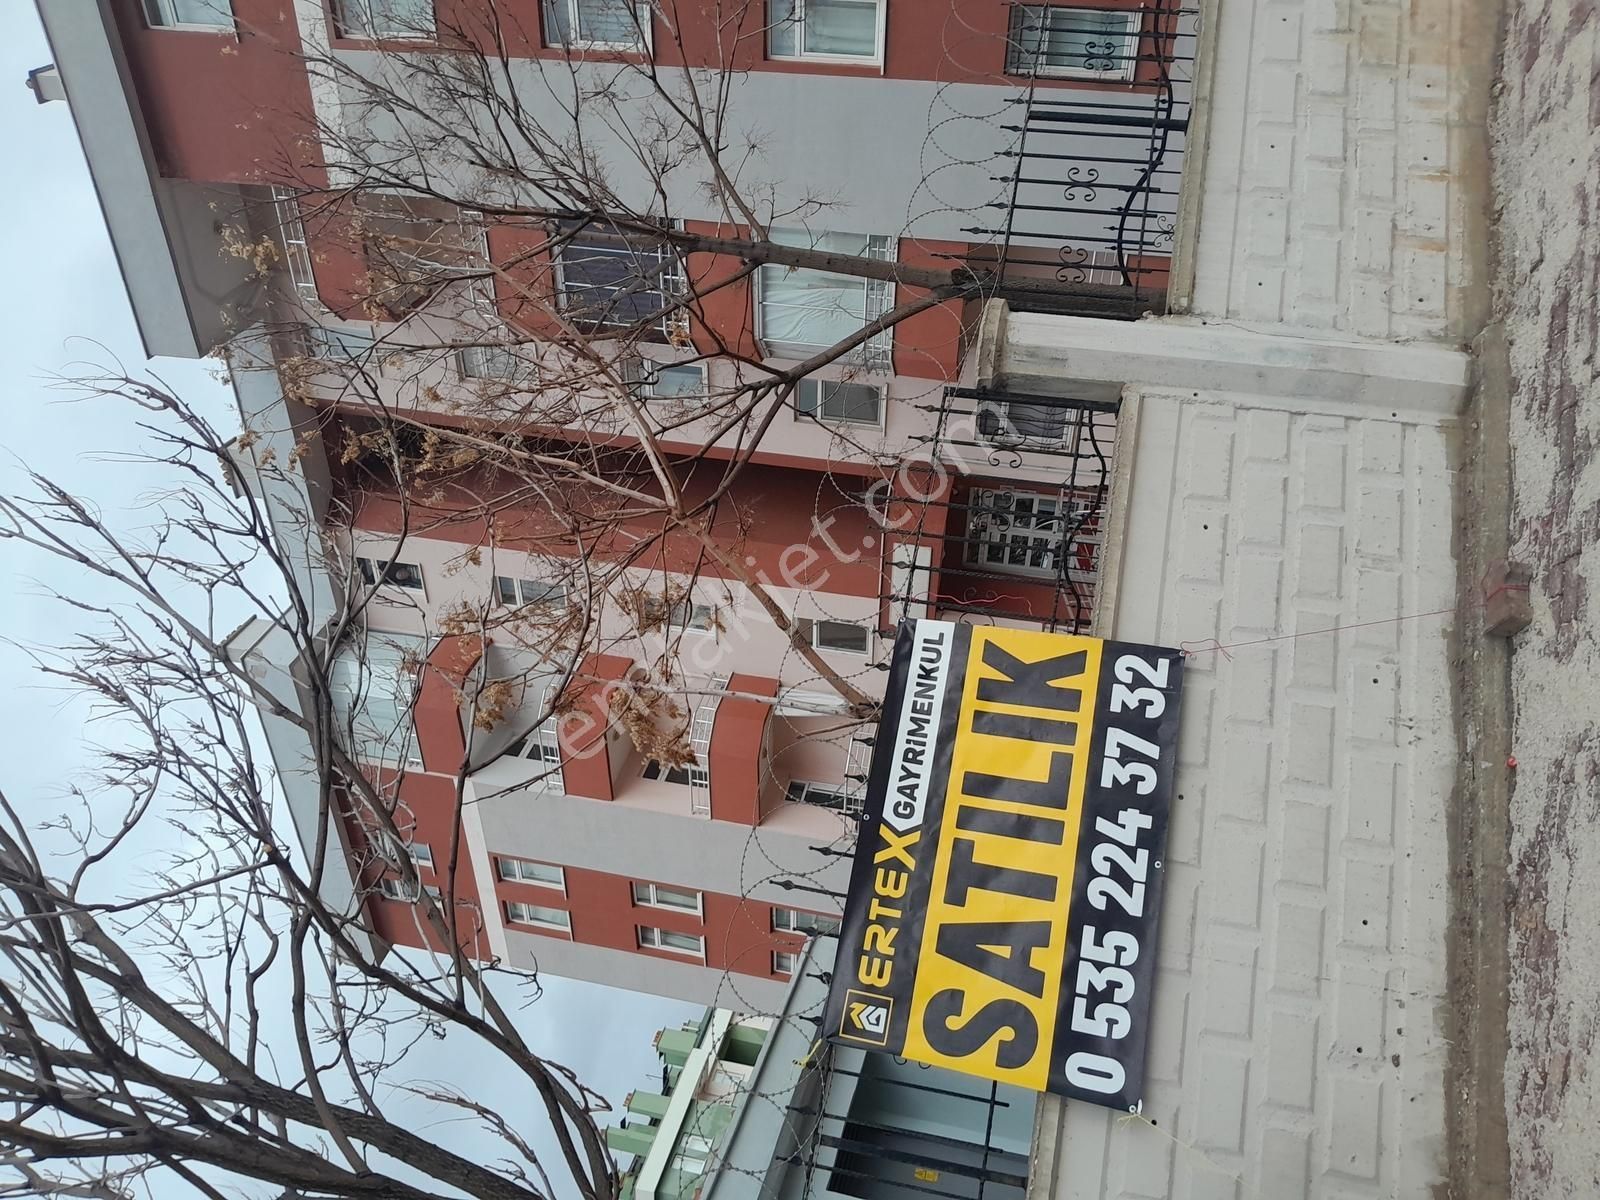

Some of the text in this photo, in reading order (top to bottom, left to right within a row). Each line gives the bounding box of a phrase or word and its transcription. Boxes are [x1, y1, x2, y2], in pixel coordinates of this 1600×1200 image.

[858, 823, 922, 988] ERTEX
[922, 638, 1088, 1070] SATILIK
[1064, 654, 1170, 1095] 0 535 224 37 32
